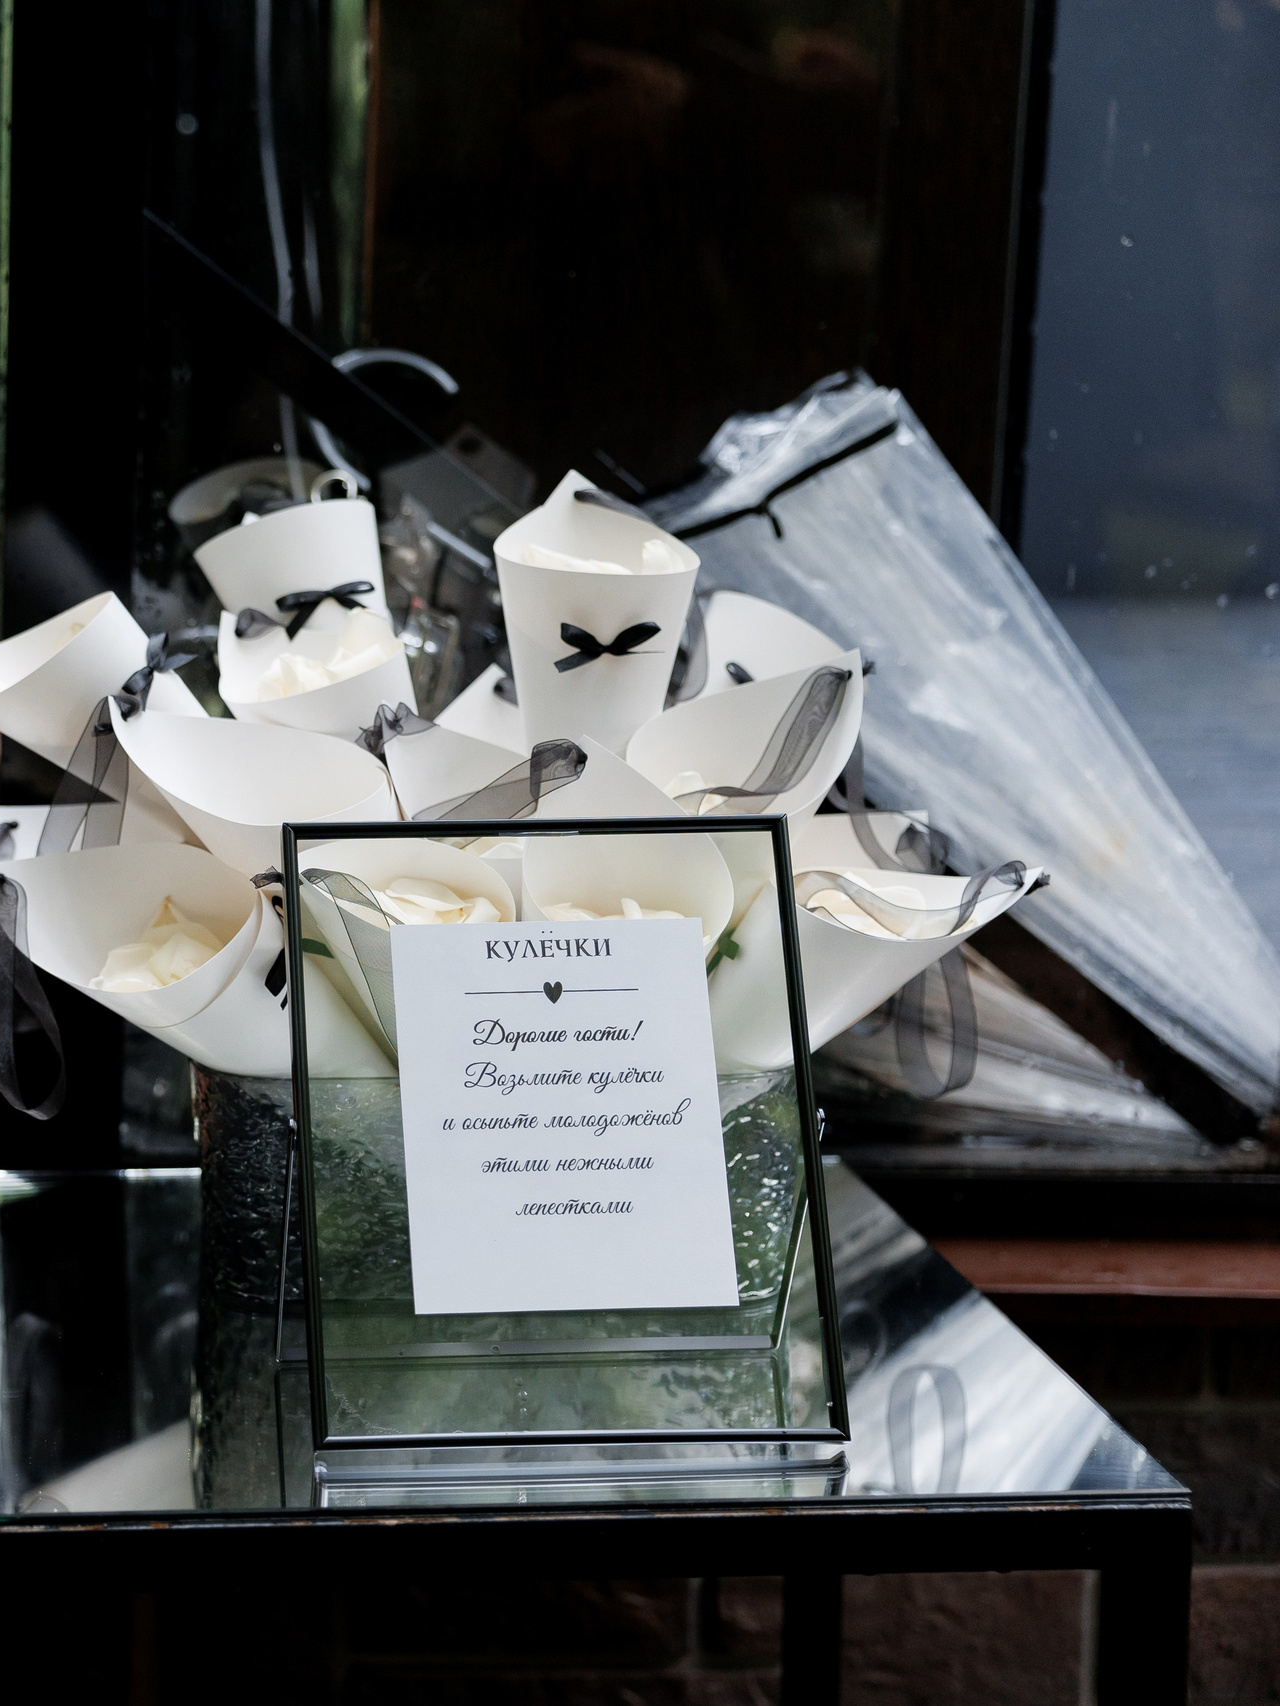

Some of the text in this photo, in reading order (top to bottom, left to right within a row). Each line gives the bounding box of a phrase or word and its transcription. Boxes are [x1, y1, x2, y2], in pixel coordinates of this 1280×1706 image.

[484, 930, 613, 962] КУЛЁЧКИ
[473, 1019, 644, 1051] Дорогие гости!
[464, 1062, 664, 1095] Возьмите кулёчки
[442, 1097, 691, 1136] и осыпьте молодожёнов
[480, 1154, 654, 1174] этими нежными
[515, 1199, 634, 1216] лепестками
